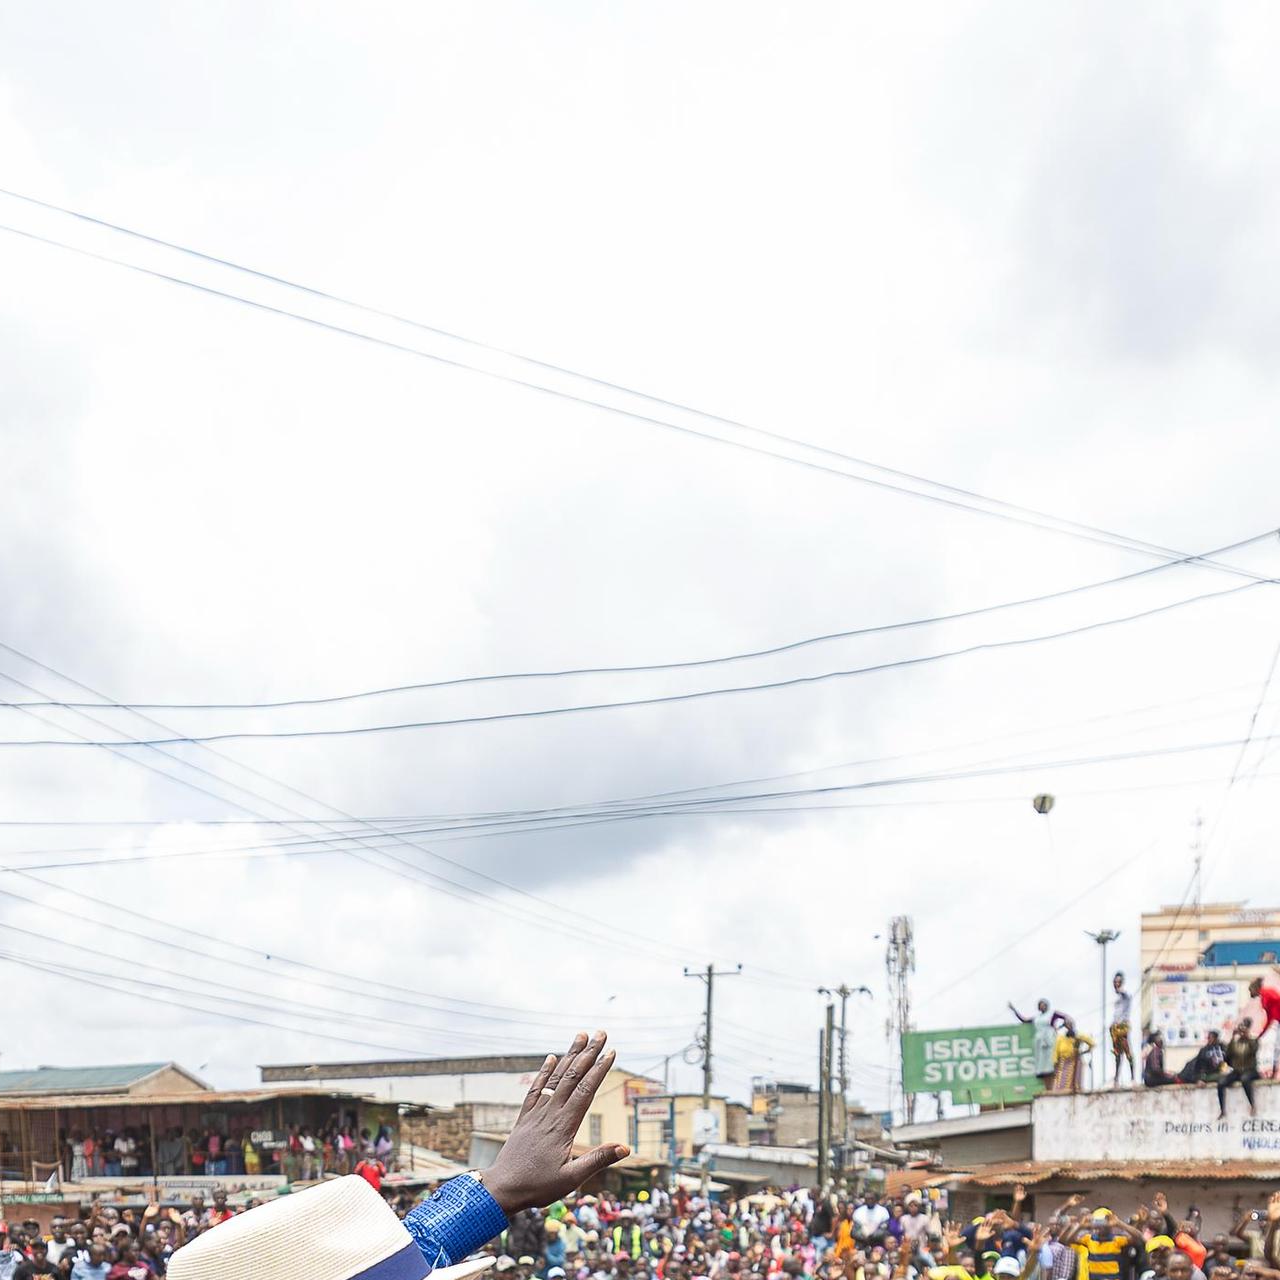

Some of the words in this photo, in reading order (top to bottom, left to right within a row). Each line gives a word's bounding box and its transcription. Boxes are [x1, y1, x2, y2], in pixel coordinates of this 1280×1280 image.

[924, 1035, 1033, 1061] ISRAEL
[924, 1056, 1037, 1084] STORES
[1164, 1120, 1213, 1136] Dealers
